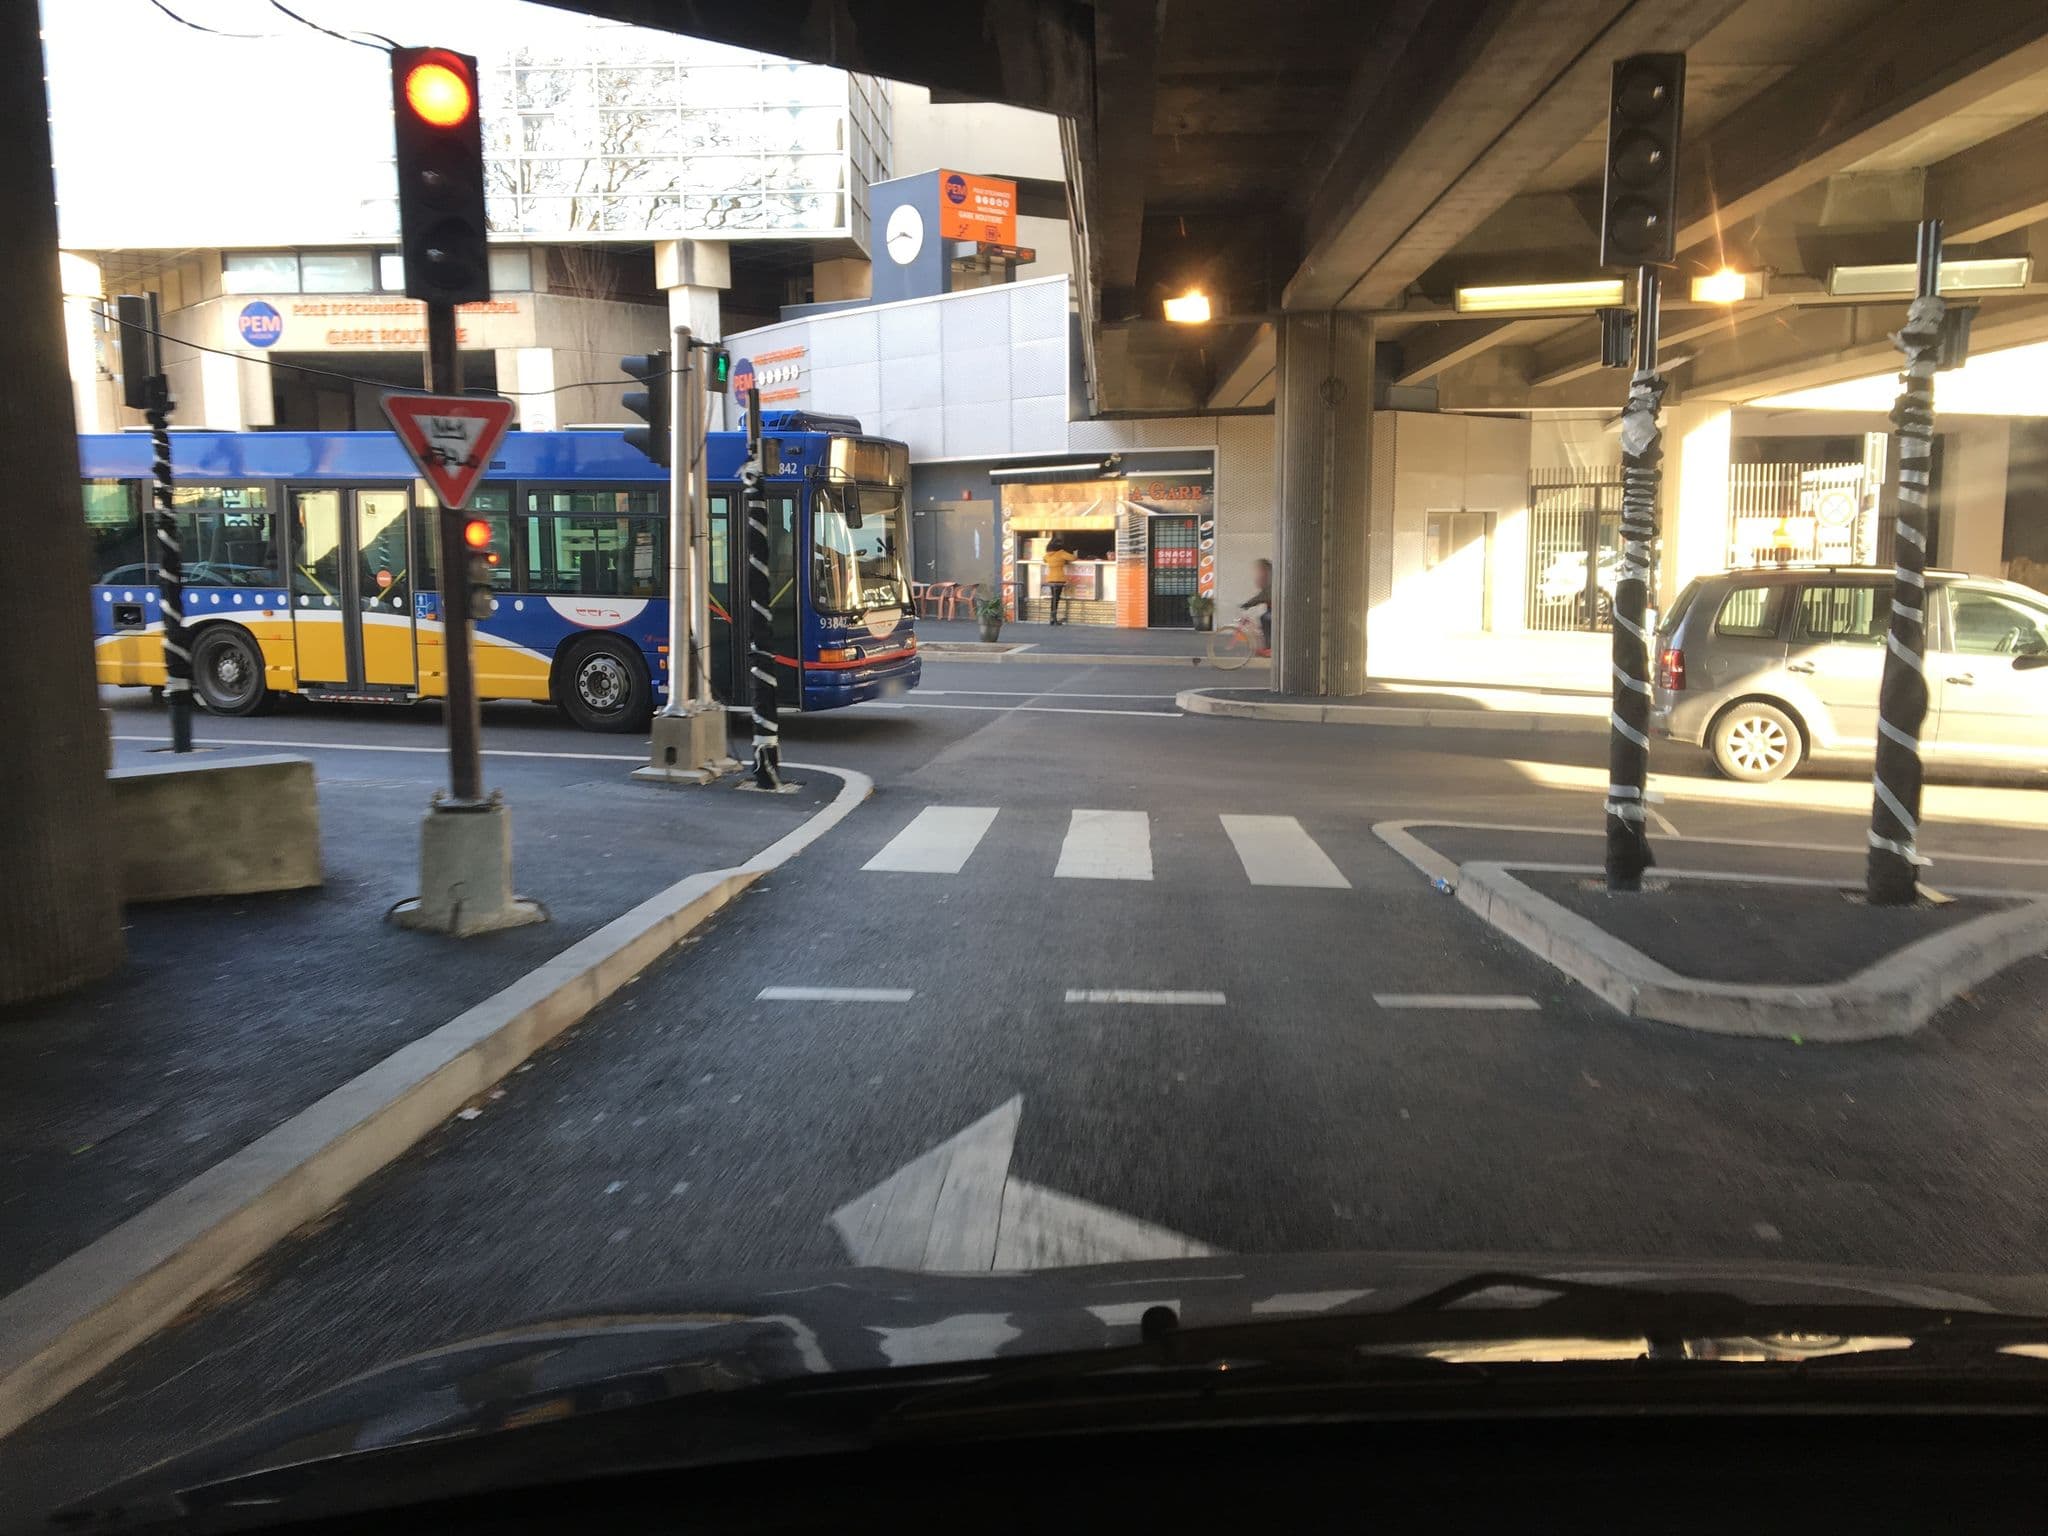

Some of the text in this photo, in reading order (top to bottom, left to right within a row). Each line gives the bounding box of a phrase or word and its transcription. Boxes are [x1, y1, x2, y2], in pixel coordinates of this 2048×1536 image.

[239, 315, 281, 333] PEM
[326, 328, 374, 345] GARE
[779, 462, 798, 475] 842
[1158, 550, 1193, 558] SNACK
